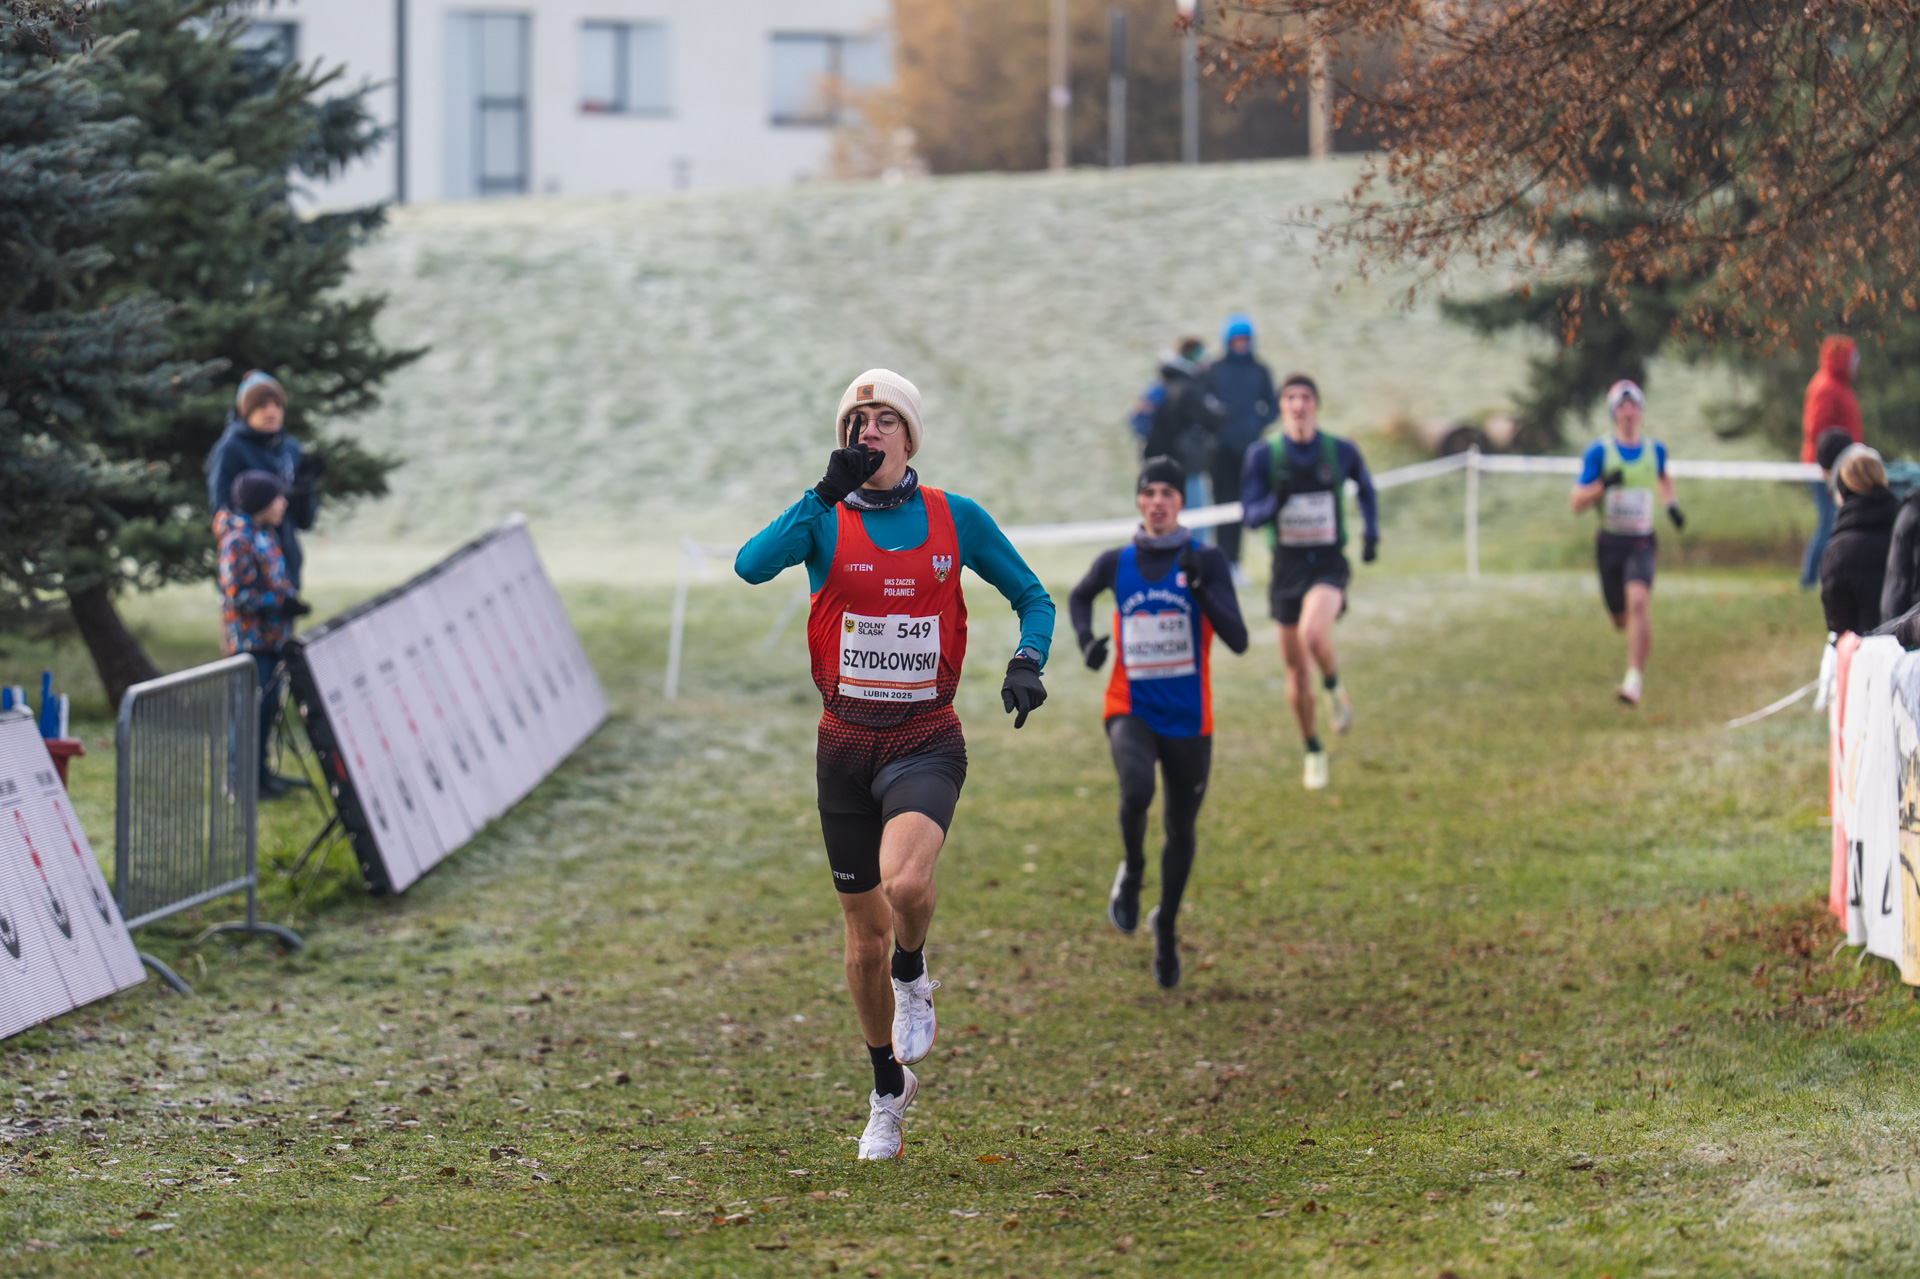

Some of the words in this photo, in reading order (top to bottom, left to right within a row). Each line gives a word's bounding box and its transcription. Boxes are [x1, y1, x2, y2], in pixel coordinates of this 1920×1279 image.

[884, 578, 895, 586] UKS
[895, 577, 916, 586] ŻACZEK
[883, 587, 915, 597] POŁANIEC
[858, 621, 886, 630] DOLNY
[896, 621, 932, 639] 549
[857, 627, 884, 637] ŚLĄSK
[843, 648, 937, 672] SZYDŁOWSKI
[863, 689, 889, 698] LUBIN
[890, 690, 913, 699] 2025
